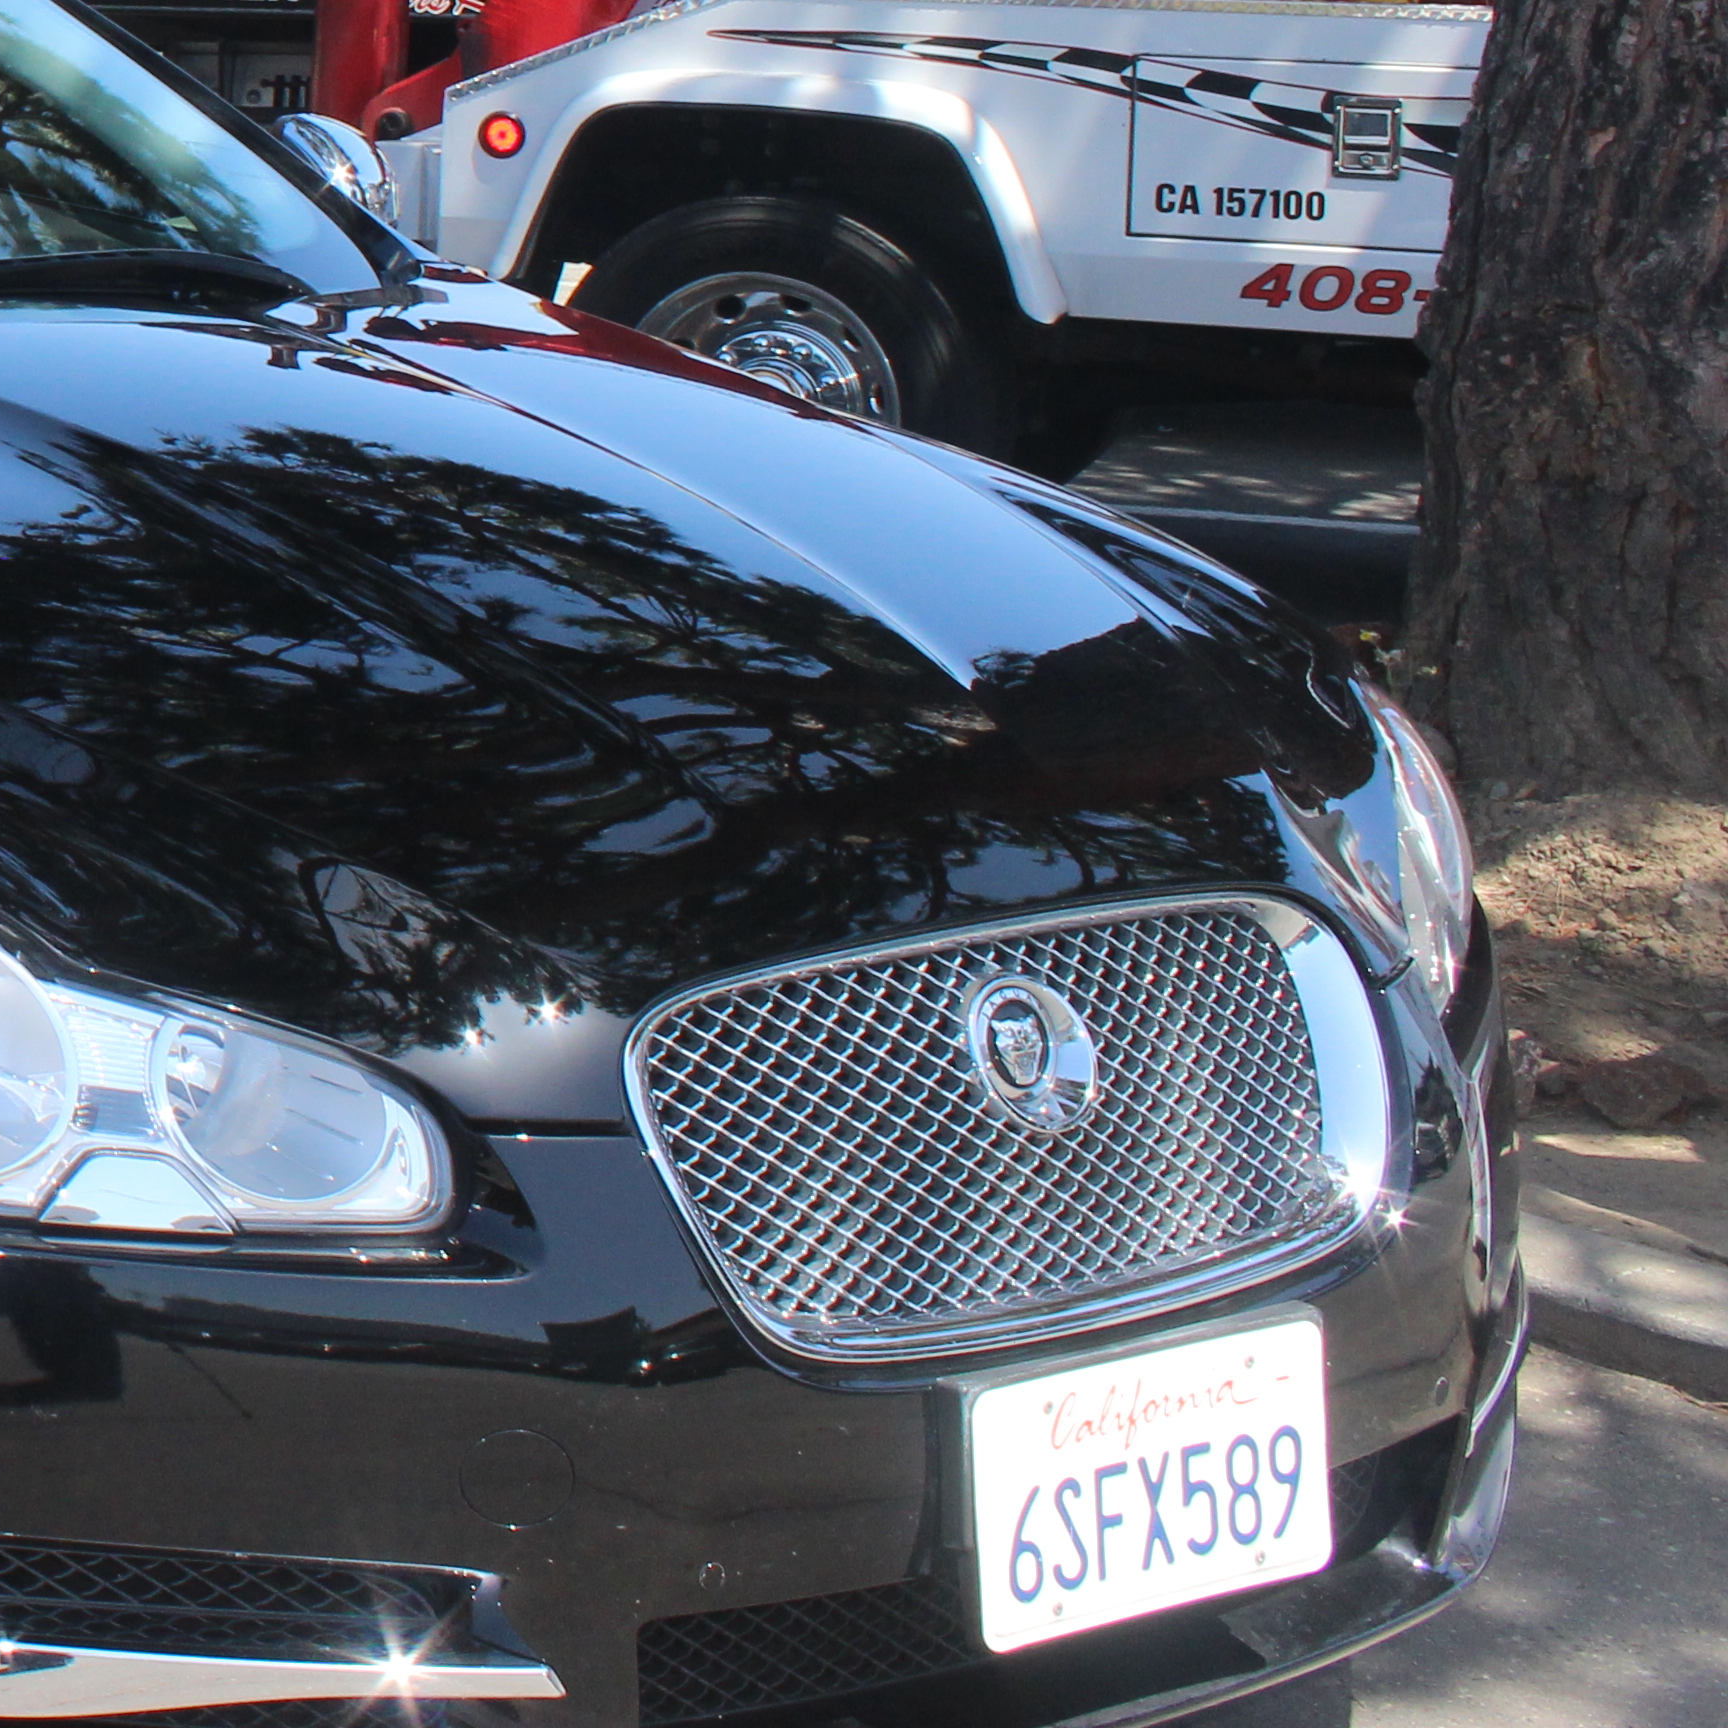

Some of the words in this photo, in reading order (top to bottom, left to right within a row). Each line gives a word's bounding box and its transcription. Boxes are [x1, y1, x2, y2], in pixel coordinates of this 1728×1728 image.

[1154, 183, 1200, 215] CA
[1212, 187, 1326, 221] 157100
[1050, 1378, 1257, 1450] California
[1009, 1424, 1303, 1603] 6SFX589
